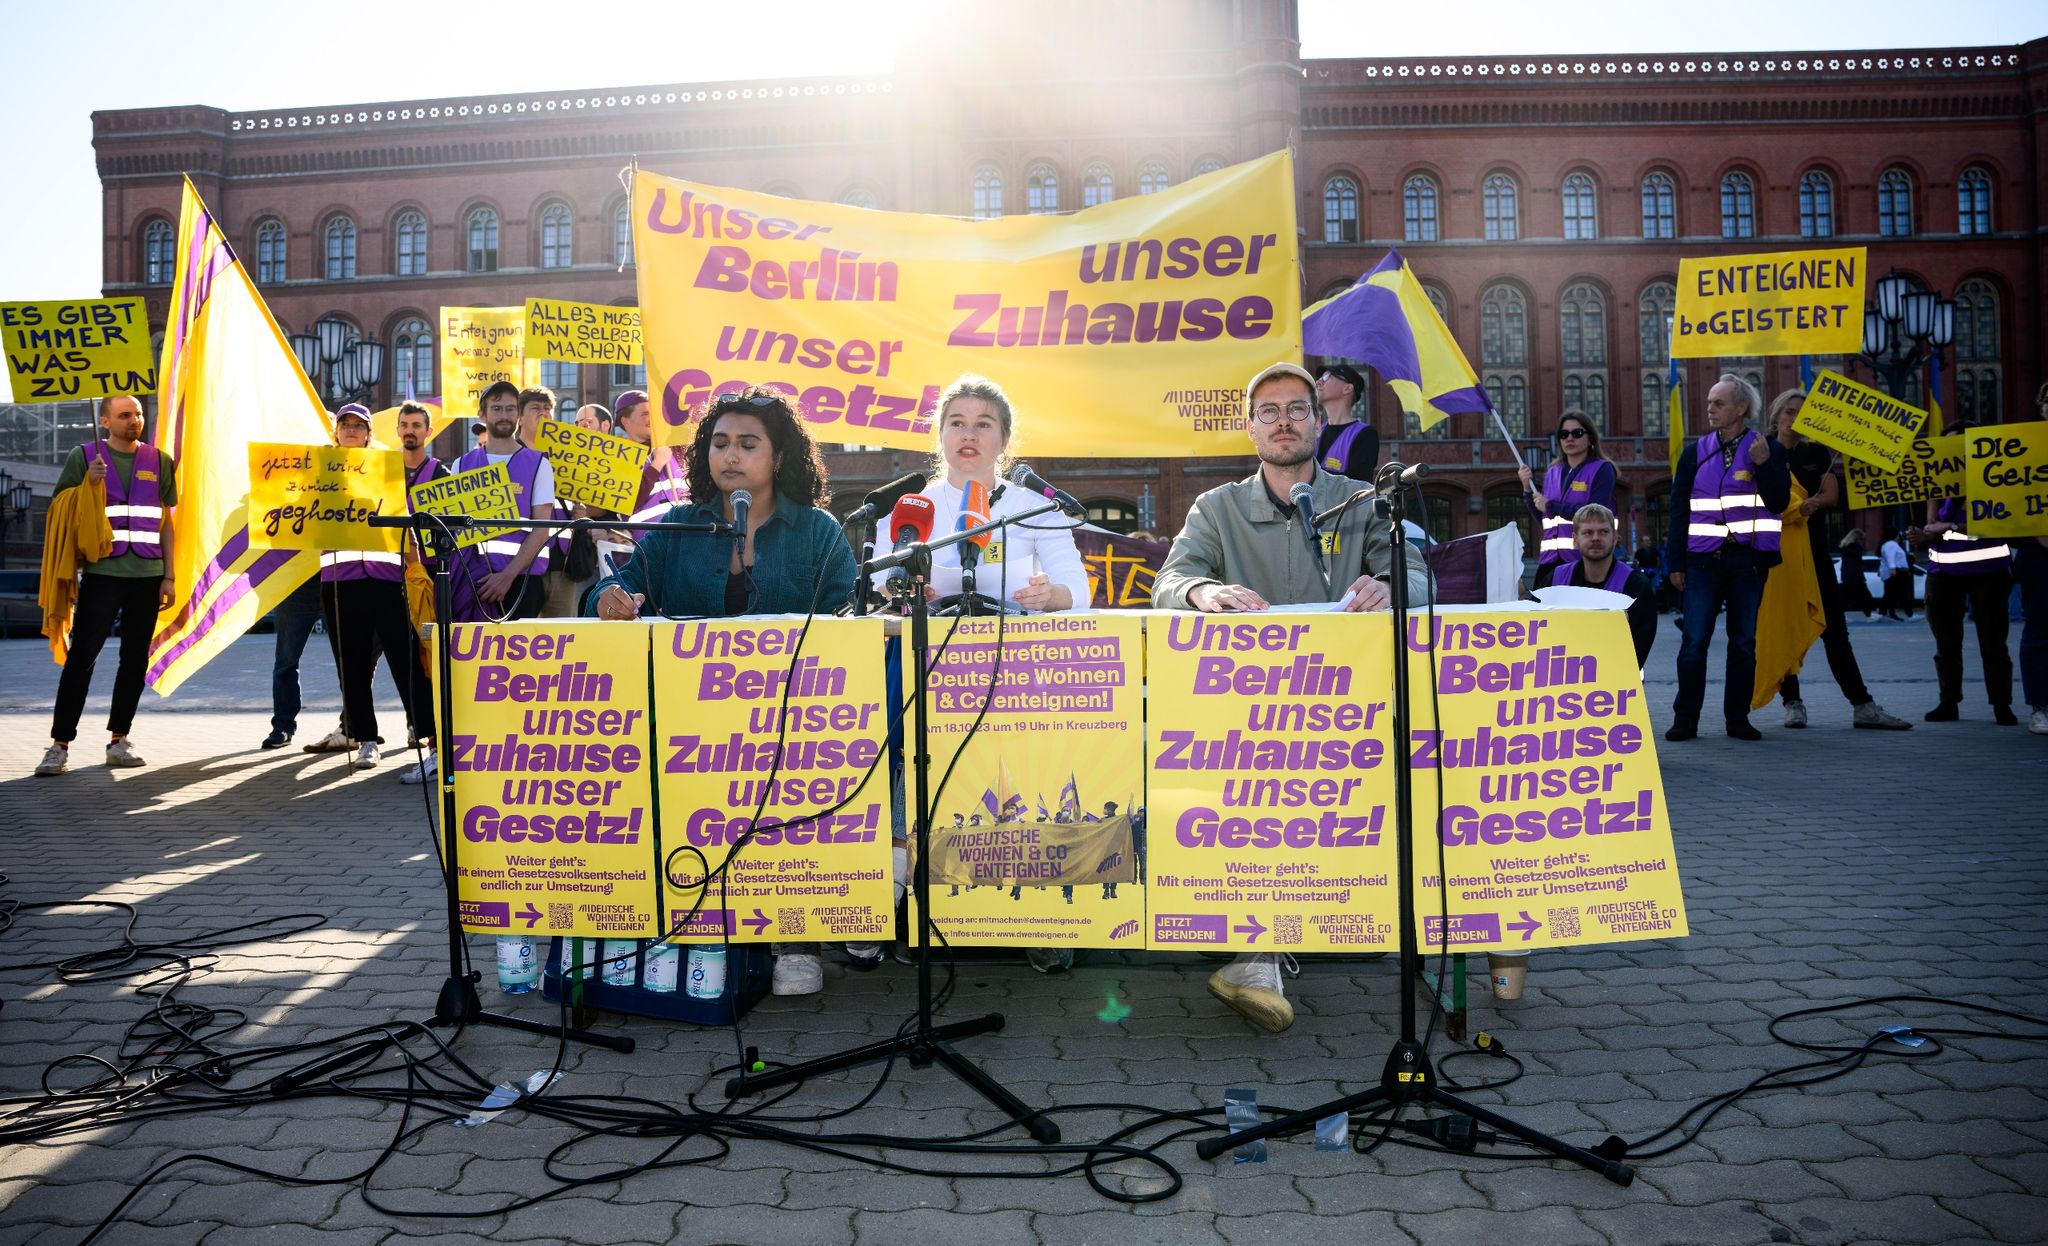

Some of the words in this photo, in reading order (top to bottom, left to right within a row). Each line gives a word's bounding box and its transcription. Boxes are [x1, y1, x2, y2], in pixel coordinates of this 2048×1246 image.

[647, 187, 833, 241] Unser
[1079, 233, 1277, 284] unser
[693, 246, 898, 302] Berlin
[1698, 256, 1855, 297] ENTEIGNEN
[1, 306, 43, 326] ES
[57, 303, 136, 325] GIBT
[604, 311, 641, 326] MUSS
[947, 290, 1273, 347] Zuhause
[1680, 305, 1848, 336] beGEISTERT
[18, 326, 128, 349] IMMER
[447, 318, 522, 345] Enteignun
[532, 321, 569, 338] MAN
[10, 351, 91, 374] WAS
[715, 325, 902, 377] unser
[30, 376, 80, 397] ZU
[92, 368, 156, 393] TUN
[466, 370, 511, 381] werden
[661, 368, 941, 434] Getz!
[1185, 389, 1247, 403] DEUTSCH
[1818, 376, 1922, 432] ENTEIGNUNG
[1178, 404, 1242, 417] WOHNEN
[1809, 399, 1842, 418] wenn
[1848, 412, 1871, 429] man
[1194, 418, 1247, 431] ENTEIG
[1801, 415, 1831, 433] alles
[262, 451, 313, 480] jetzt
[327, 459, 367, 474] wird
[1924, 456, 1966, 476] MAN
[1983, 461, 2048, 487] GeIS
[415, 467, 502, 506] ENTEIGNEN
[947, 621, 995, 636] Jetzt
[1001, 618, 1097, 634] anmelden:
[1167, 616, 1310, 651] Unser
[1407, 615, 1548, 652] Unser
[451, 625, 575, 661] Unser
[672, 622, 803, 659] Unser
[931, 644, 1072, 666] Neuentreffen
[1076, 643, 1116, 658] von
[474, 662, 613, 702] Berlin
[697, 656, 847, 701] Berlin
[928, 669, 1029, 688] Deutsche
[1033, 667, 1120, 685] Wohnen
[1193, 653, 1353, 696] Berlin
[1438, 645, 1598, 695] Berlin
[939, 692, 955, 709] &
[959, 692, 988, 709] Co
[994, 690, 1109, 712] enteignen!
[1496, 689, 1637, 727] unser
[523, 709, 642, 736] unser
[749, 702, 880, 734] unser
[944, 722, 990, 733] 18.1023
[993, 723, 1011, 732] um
[1014, 722, 1027, 732] 19
[1029, 721, 1050, 731] Uhr
[1053, 720, 1063, 731] in
[1066, 719, 1128, 733] Kreuzberg
[1247, 701, 1386, 732] unser
[453, 733, 642, 773] Zuhause
[664, 733, 879, 774] Zuhause
[1154, 730, 1385, 771] Zuhause
[1410, 723, 1643, 769] Zuhause
[502, 779, 622, 806] unser
[727, 776, 857, 808] unser
[1222, 777, 1362, 807] unser
[1479, 762, 1623, 803] unser
[463, 805, 644, 845] Gesetz!
[686, 803, 881, 848] Gesetz!
[1175, 805, 1386, 849] Gesetz!
[1435, 789, 1653, 847] Gesetz!
[505, 855, 546, 866] Weiter
[549, 856, 586, 869] geht's:
[731, 859, 775, 871] Weiter
[778, 858, 819, 873] geht's:
[959, 846, 1023, 863] WOHNEN
[1029, 845, 1041, 860] &
[1045, 844, 1068, 860] CO
[1490, 858, 1540, 871] Weiter
[1543, 852, 1590, 870] geht's:
[471, 868, 505, 878] einem
[508, 868, 646, 881] Gesetzesvolksentscheid
[671, 873, 692, 884] Mit
[734, 869, 884, 884] Gesetzesvolksentscheid
[974, 861, 1062, 879] ENTEIGNEN
[1157, 875, 1179, 887] Mit
[1183, 876, 1223, 887] einem
[1227, 874, 1388, 888] Gesetzesvolksentscheid
[1225, 862, 1272, 874] Weiter
[1275, 862, 1319, 876] geht's:
[1448, 875, 1491, 888] einem
[1494, 858, 1666, 885] Gesetzesvolksentscheid
[480, 880, 522, 891] endlich
[525, 882, 545, 891] zur
[546, 881, 614, 895] Umsetzung!
[704, 885, 749, 897] endlich
[752, 886, 772, 896] zur
[775, 883, 850, 898] Umsetzung!
[1194, 889, 1243, 902] endlich
[1247, 891, 1269, 902] zur
[1272, 889, 1351, 904] Umsetzung!
[1461, 886, 1512, 900] endlich
[1516, 886, 1539, 898] zur
[1542, 877, 1628, 896] Umsetzung!
[587, 913, 626, 923] WOHNEN
[628, 914, 636, 922] &
[638, 913, 650, 922] CO
[596, 922, 645, 931] ENTEIGNEN
[820, 915, 862, 925] WOHNEN
[865, 915, 873, 924] &
[875, 914, 888, 924] CO
[1157, 917, 1192, 927] JETZT
[1598, 911, 1647, 924] WOHNEN
[1651, 911, 1659, 920] &
[1661, 908, 1676, 919] CO
[1611, 919, 1672, 934] ENTEIGNEN
[830, 924, 883, 934] ENTEIGNEN
[1157, 929, 1216, 940] SPENDEN!
[1319, 924, 1363, 934] WOHNEN
[1366, 924, 1375, 933] &
[1378, 924, 1391, 934] CO
[1329, 934, 1385, 944] ENTEIGNEN
[1428, 930, 1489, 943] SPENDEN!
